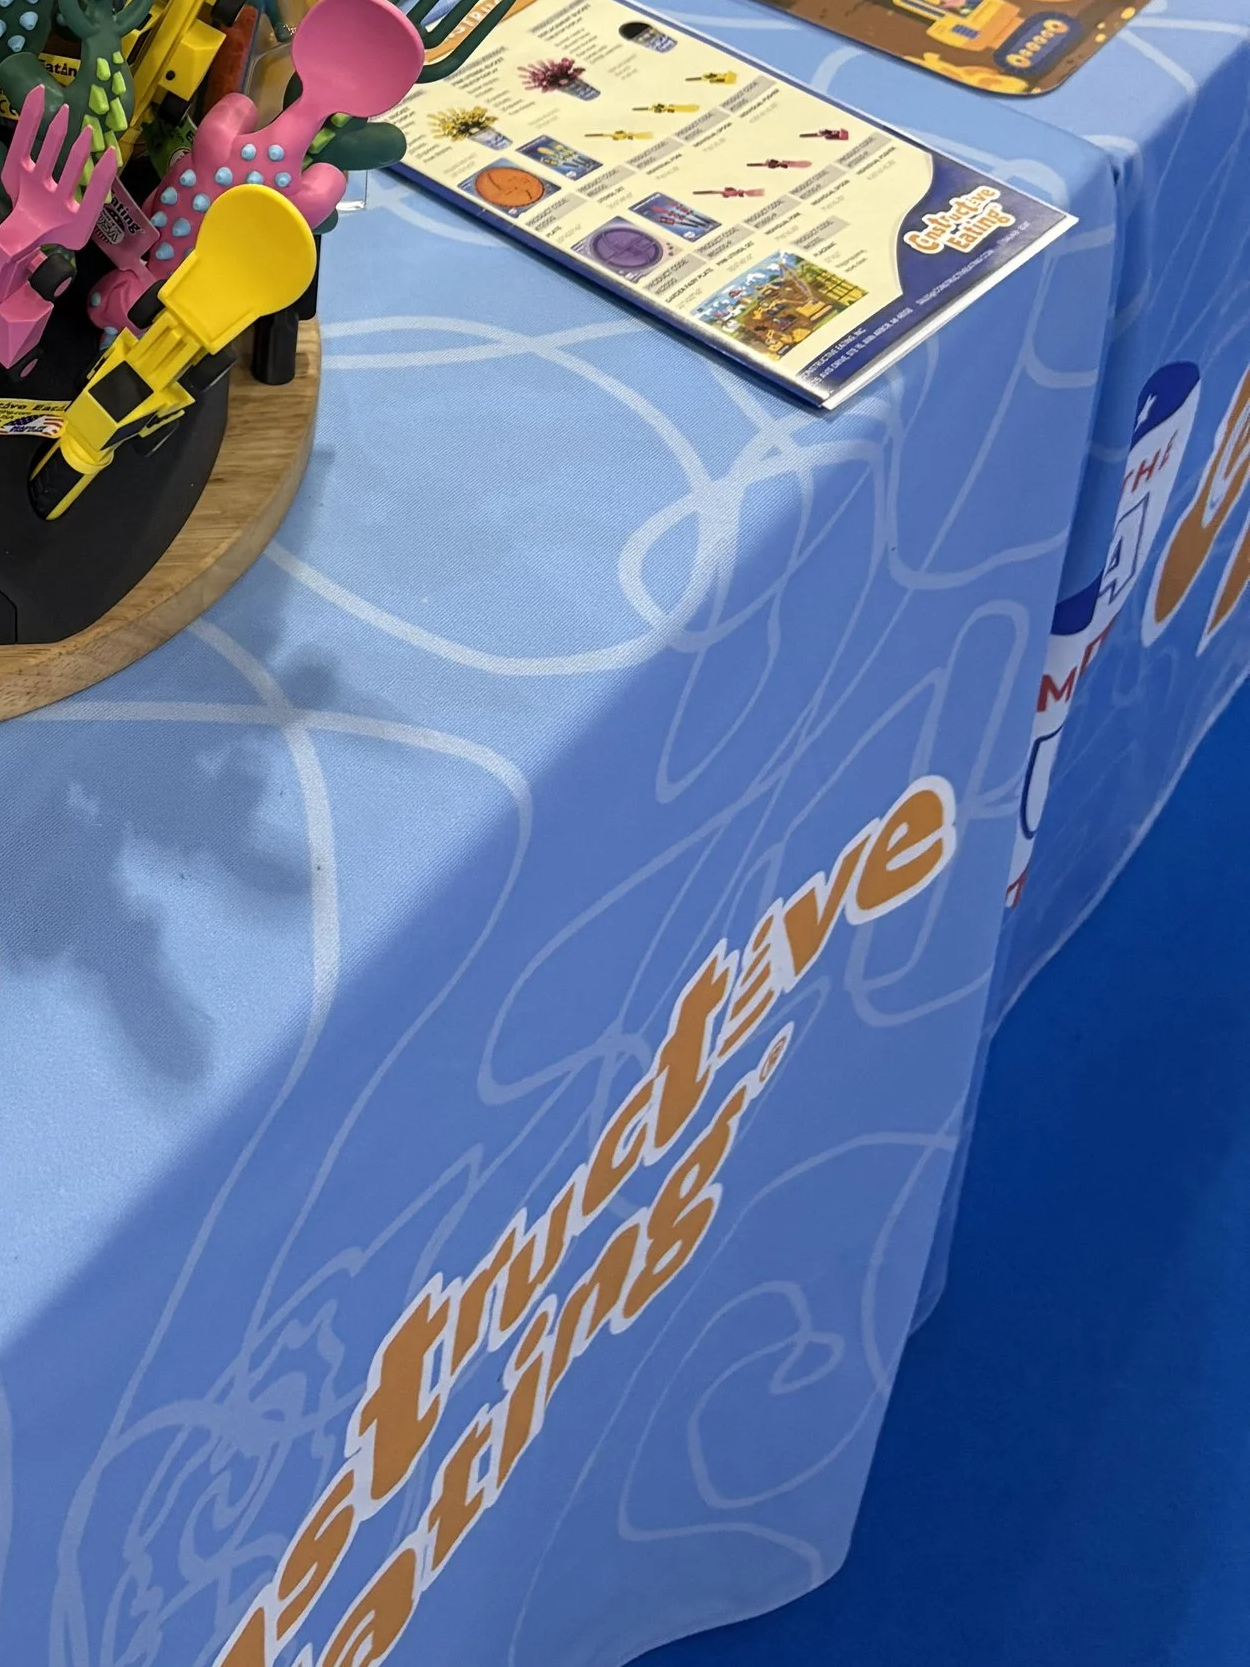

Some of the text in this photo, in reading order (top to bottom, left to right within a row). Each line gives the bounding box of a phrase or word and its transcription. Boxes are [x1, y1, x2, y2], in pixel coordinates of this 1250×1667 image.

[907, 187, 997, 251] Constructive
[946, 208, 1011, 250] Eating
[32, 404, 67, 413] Eat
[218, 786, 948, 1667] structive
